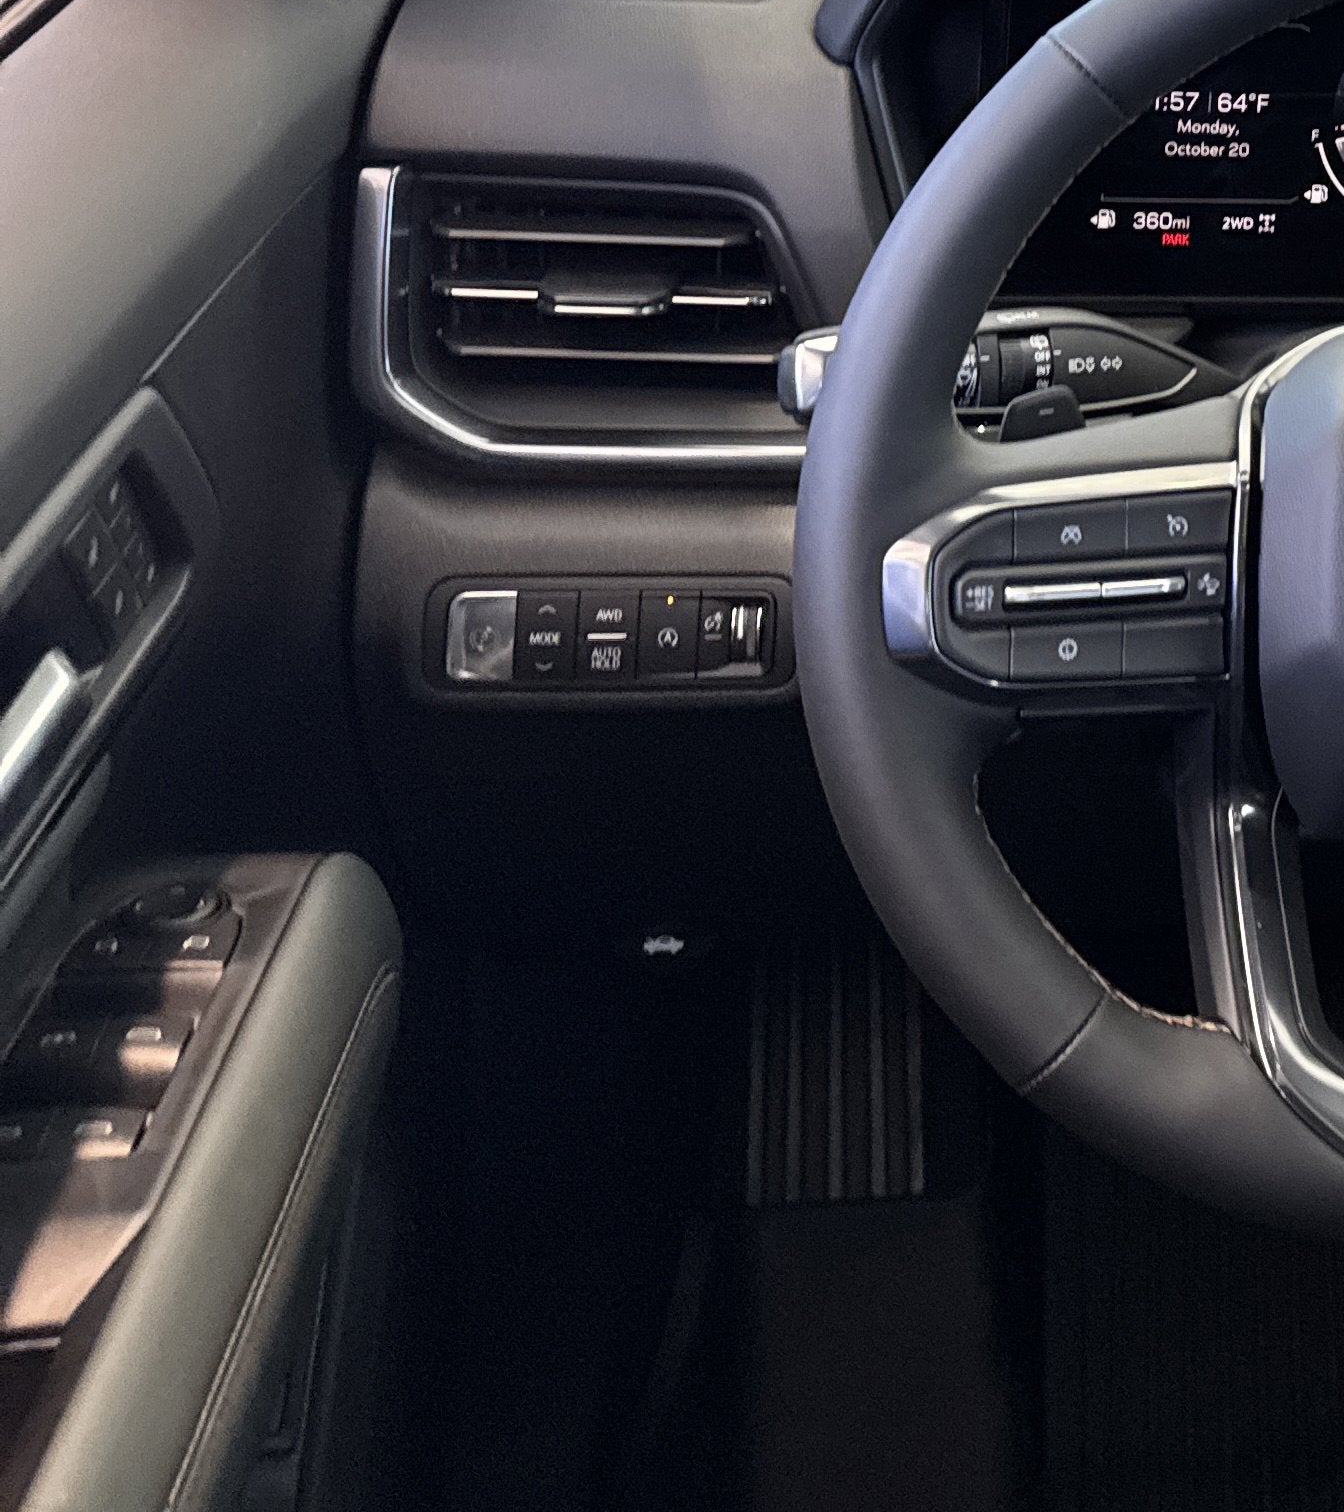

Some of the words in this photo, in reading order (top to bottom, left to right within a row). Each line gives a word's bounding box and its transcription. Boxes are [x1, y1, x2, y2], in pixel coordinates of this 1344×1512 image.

[1217, 92, 1270, 114] 64°F
[1176, 118, 1240, 138] Monday,
[1311, 129, 1320, 142] F
[1164, 140, 1225, 157] October
[1228, 142, 1250, 158] 20
[1132, 211, 1190, 230] 360mi
[1221, 215, 1254, 231] 2WD
[1161, 233, 1190, 246] PARK
